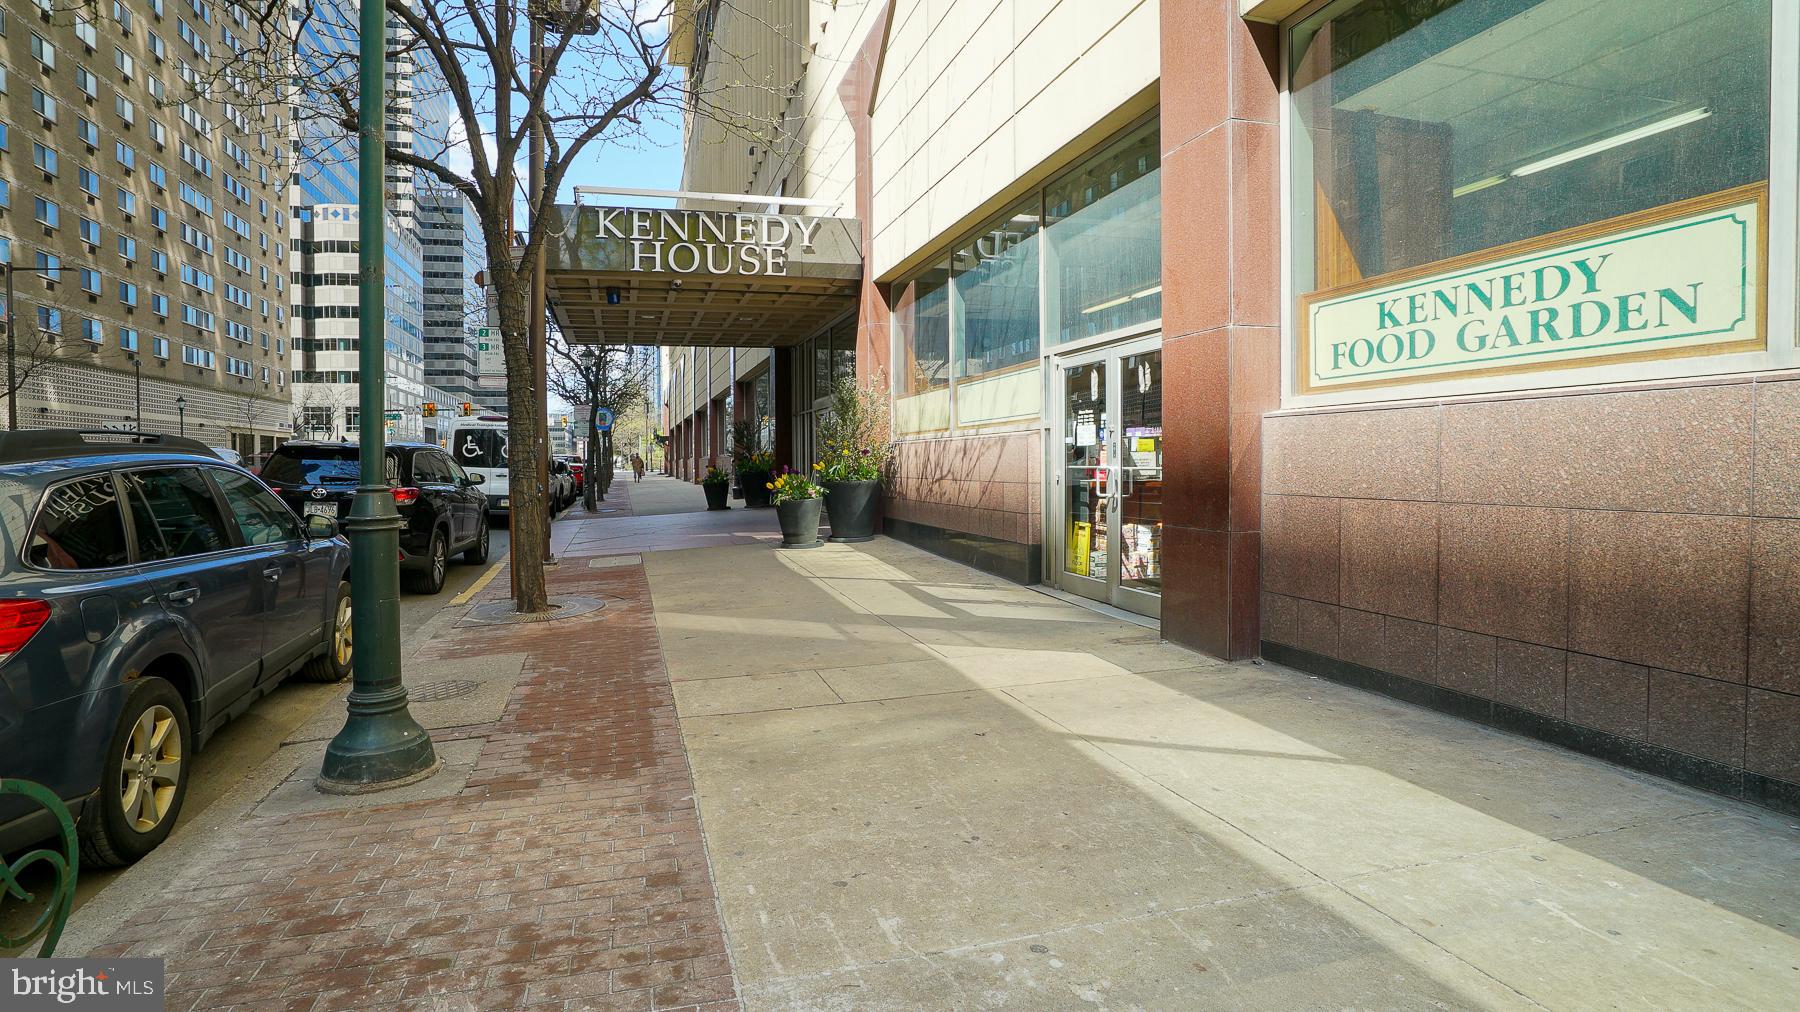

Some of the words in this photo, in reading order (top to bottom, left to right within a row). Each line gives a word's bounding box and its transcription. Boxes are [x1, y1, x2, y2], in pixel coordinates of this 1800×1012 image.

[595, 207, 820, 247] KENNEDY
[630, 240, 787, 276] HOUSE
[1377, 253, 1613, 331] KENNEDY
[1330, 328, 1436, 370] FOOD
[1456, 282, 1703, 353] GARDEN
